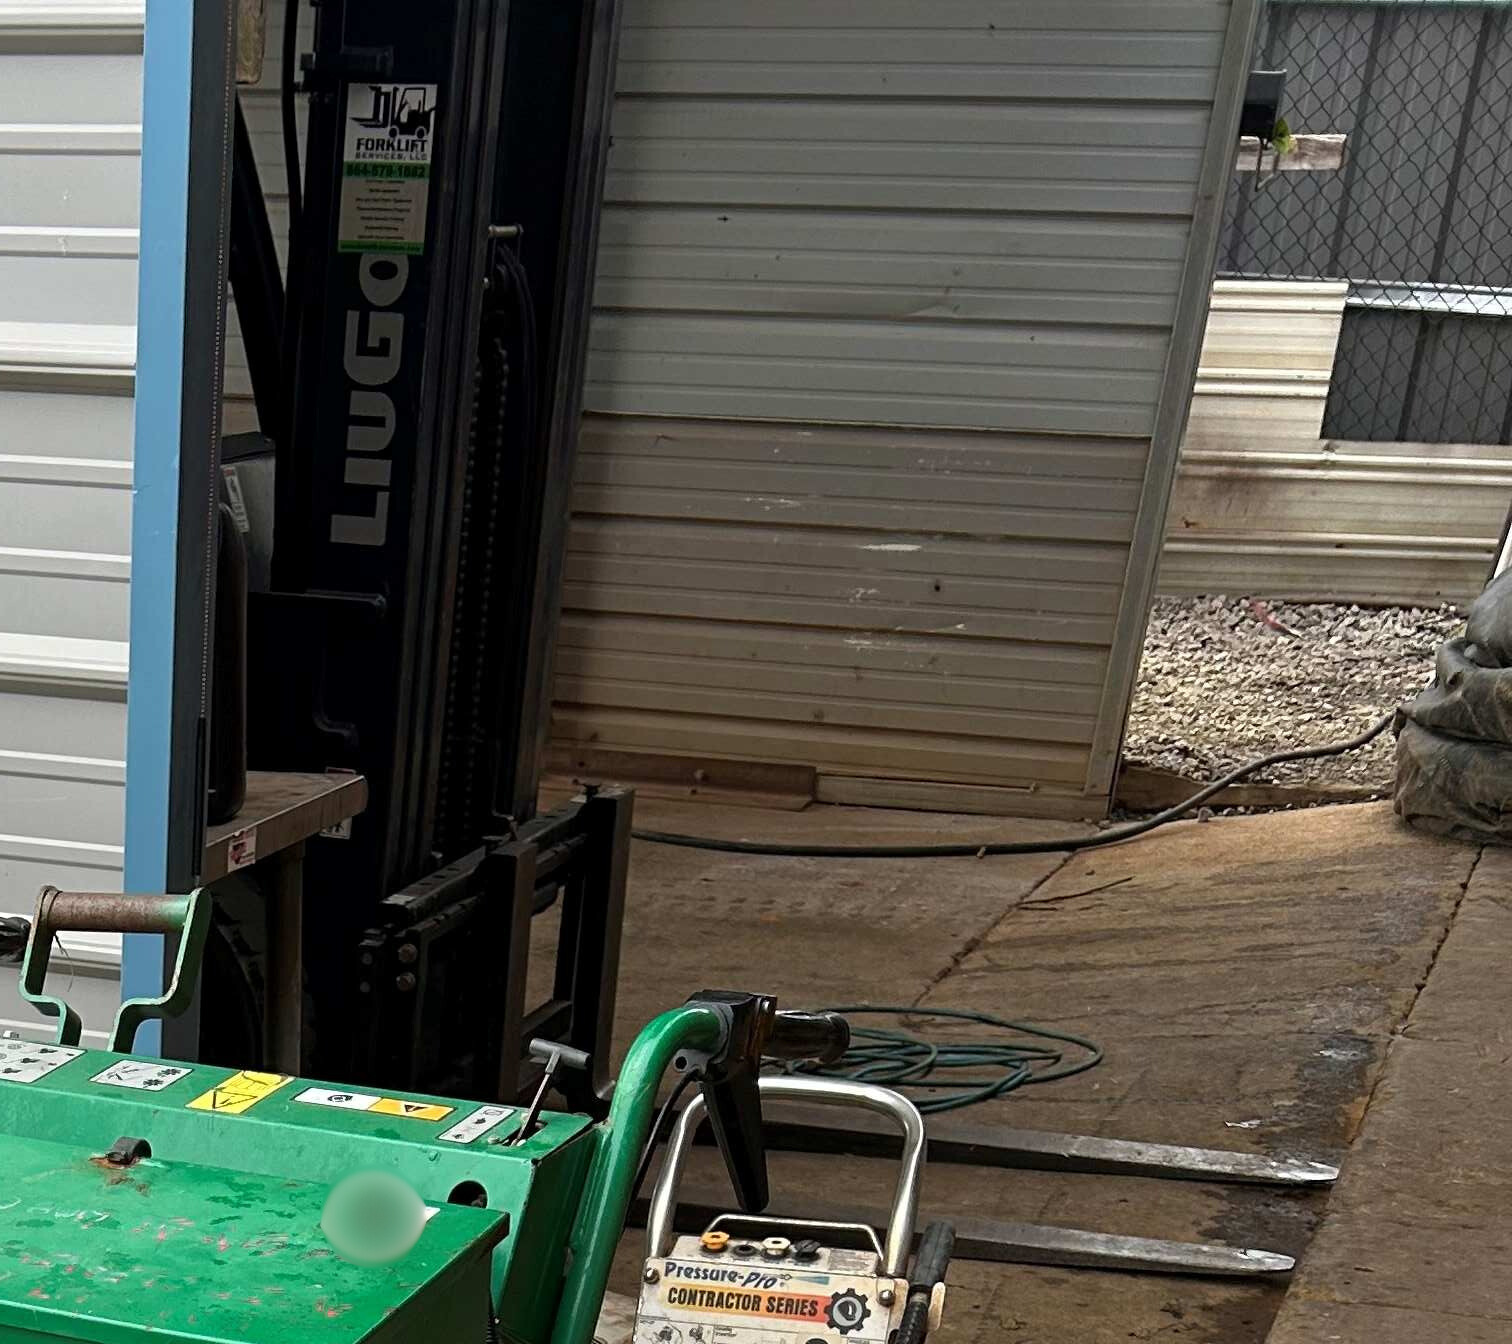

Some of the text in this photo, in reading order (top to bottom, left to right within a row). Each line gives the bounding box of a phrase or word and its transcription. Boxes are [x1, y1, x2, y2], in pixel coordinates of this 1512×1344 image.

[356, 137, 428, 152] FORKLIFT
[330, 254, 409, 546] LIUGO
[668, 1287, 819, 1318] CONTRACTOR SERIES
